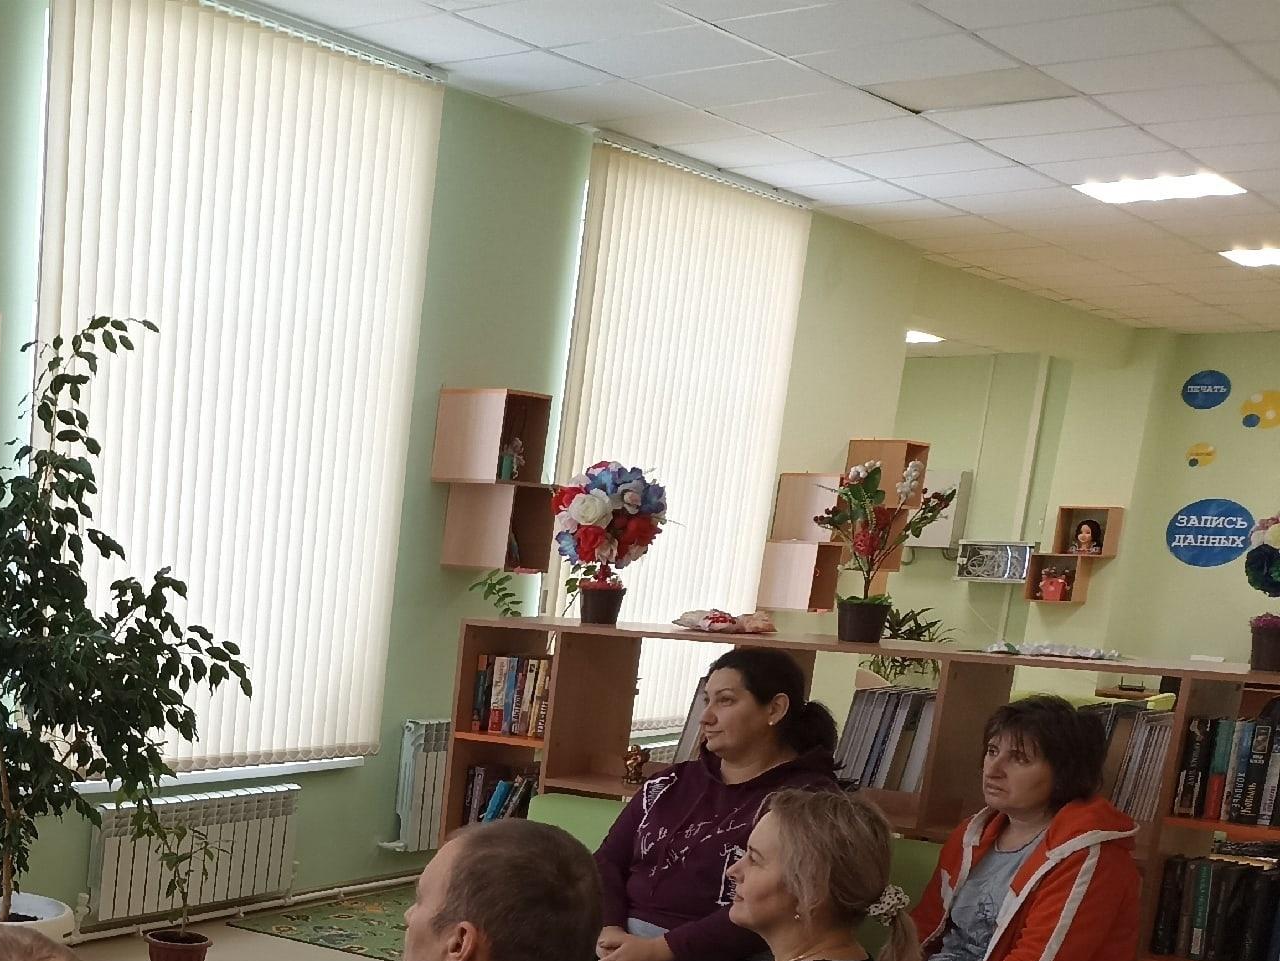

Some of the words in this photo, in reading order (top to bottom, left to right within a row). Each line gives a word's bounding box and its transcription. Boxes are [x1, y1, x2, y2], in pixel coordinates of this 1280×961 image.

[1187, 385, 1227, 393] ПЕЧАТЬ
[1175, 514, 1248, 529] ЗАПИСЬ
[1171, 534, 1245, 548] ДАННЫХ
